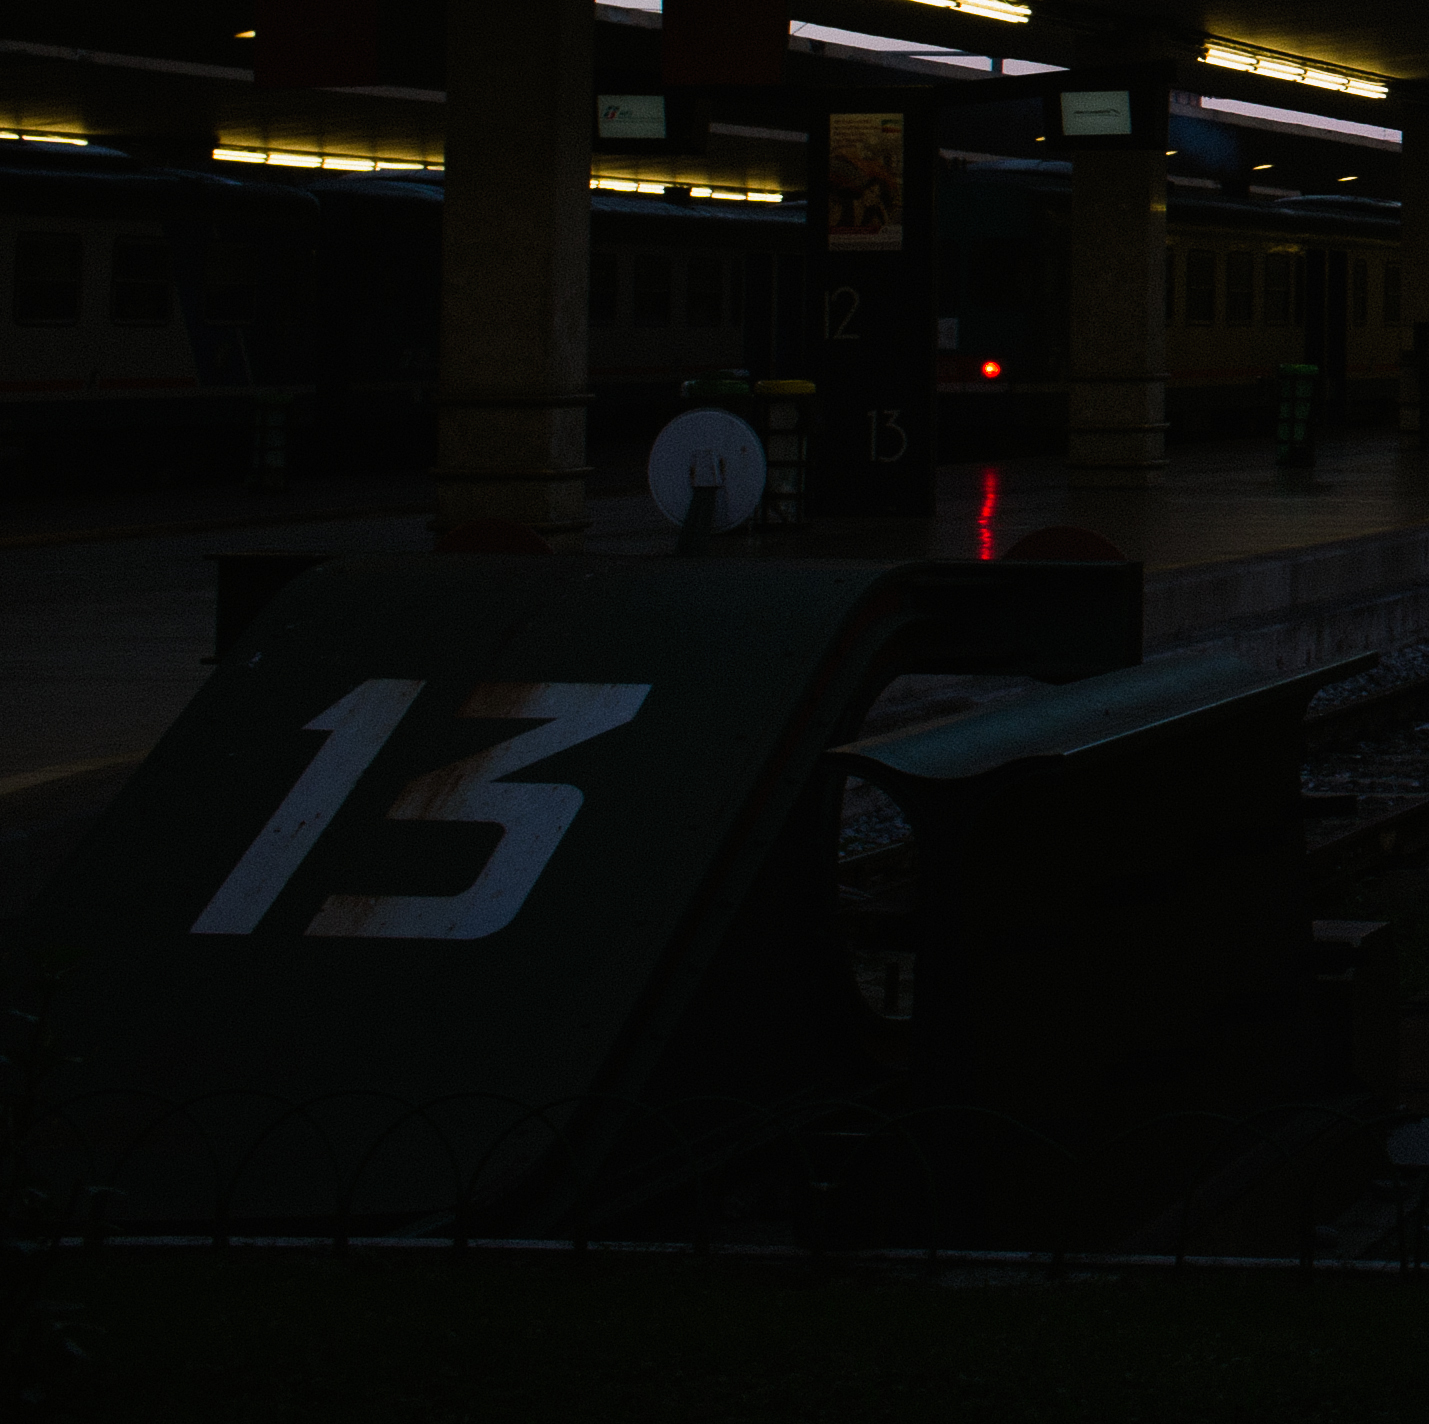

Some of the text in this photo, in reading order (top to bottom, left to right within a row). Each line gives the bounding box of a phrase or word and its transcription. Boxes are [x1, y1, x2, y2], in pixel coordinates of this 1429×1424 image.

[822, 285, 862, 341] 12
[866, 408, 909, 464] 13
[188, 676, 654, 942] 13
